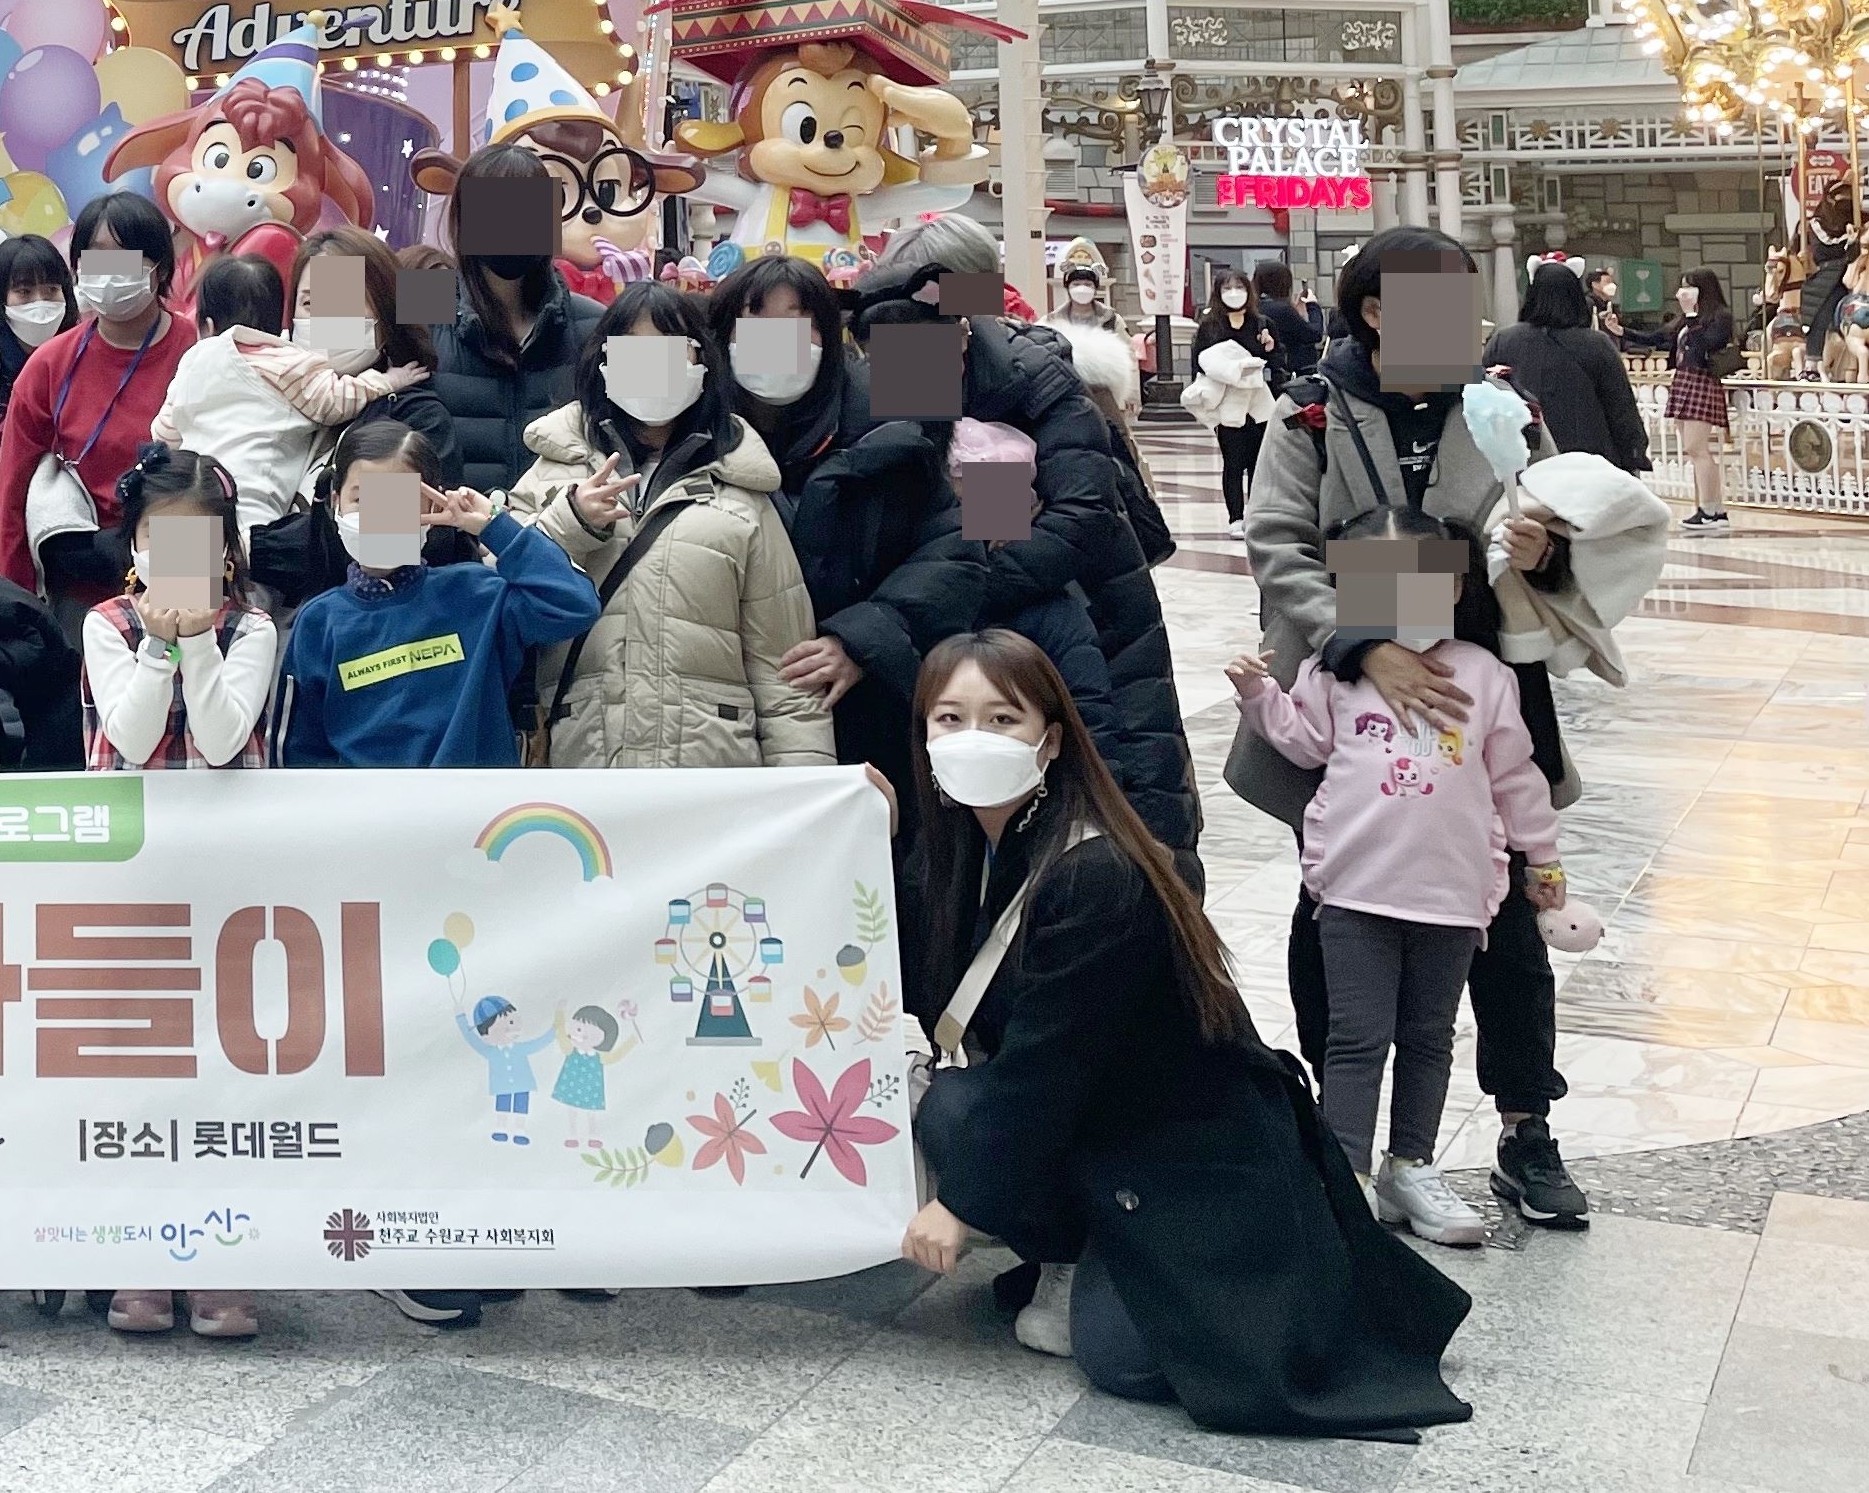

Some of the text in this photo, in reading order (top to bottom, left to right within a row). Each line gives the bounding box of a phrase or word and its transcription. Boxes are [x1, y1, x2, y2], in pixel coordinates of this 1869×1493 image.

[1212, 117, 1370, 149] CRYSTAL
[1227, 146, 1361, 177] PALACE
[1234, 175, 1373, 209] FRIDAYS
[347, 643, 457, 680] ALWAYS FIRST NEPA
[192, 1120, 342, 1161] 롯데월드
[376, 1210, 439, 1225] 사회복지법인
[34, 1225, 152, 1244] 살맛나는 생생도시
[379, 1227, 555, 1246] 천주교 수원교구 사회복지회
